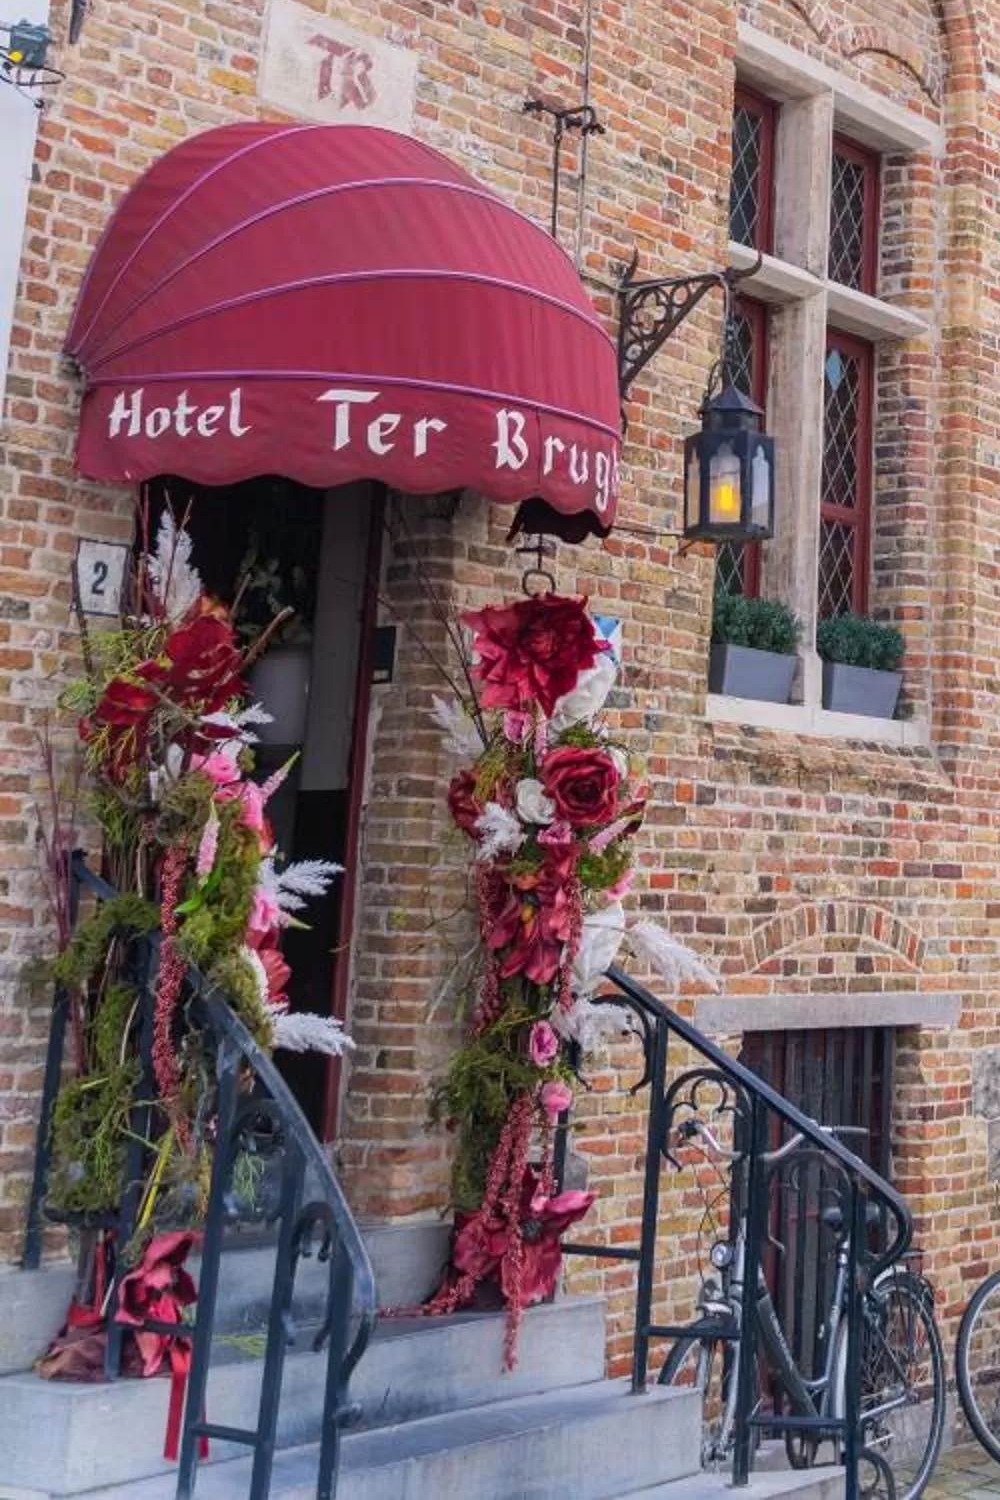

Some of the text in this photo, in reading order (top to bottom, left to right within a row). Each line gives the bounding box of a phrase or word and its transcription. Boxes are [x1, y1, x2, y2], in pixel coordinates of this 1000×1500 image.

[108, 387, 252, 439] Hotel
[316, 389, 448, 458] Ter
[91, 561, 109, 596] 2
